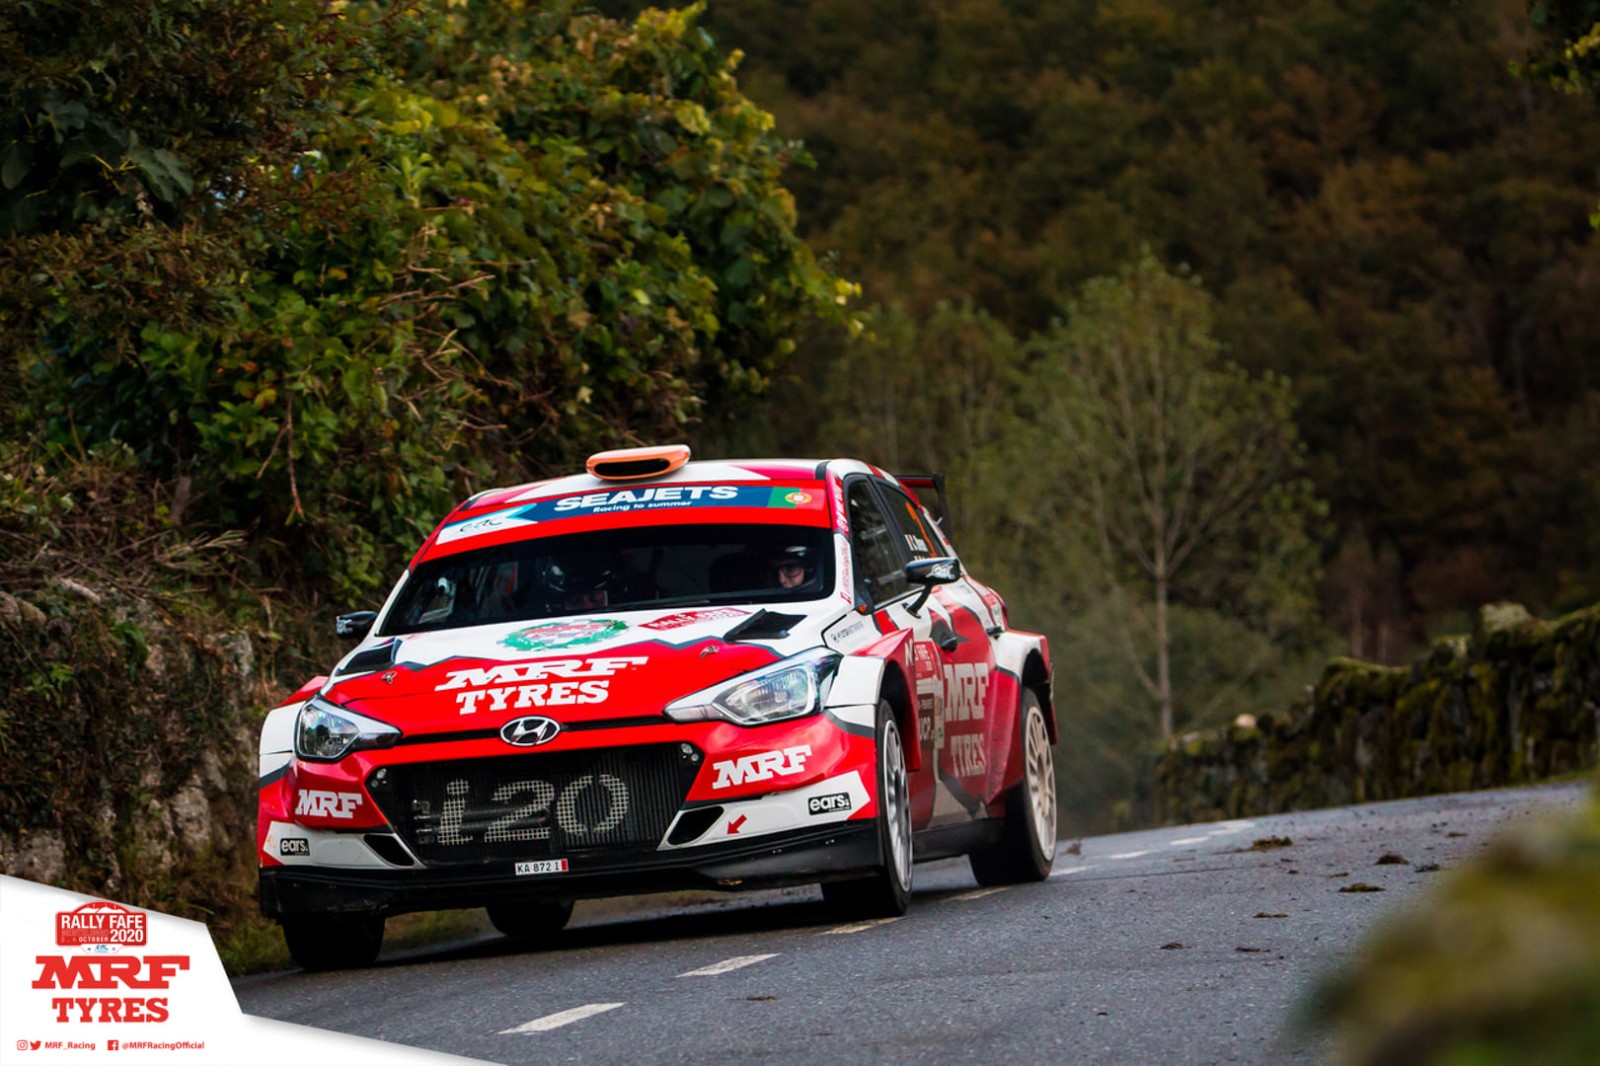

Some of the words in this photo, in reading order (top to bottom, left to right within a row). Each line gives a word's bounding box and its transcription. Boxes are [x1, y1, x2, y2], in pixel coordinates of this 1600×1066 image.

[554, 486, 738, 511] SEAJETS
[593, 503, 630, 513] Racing
[648, 501, 692, 509] summer
[434, 656, 649, 691] MRF
[455, 680, 610, 715] TYRES
[943, 662, 989, 722] MRF
[711, 744, 812, 790] MRF
[951, 733, 986, 777] TYRES
[295, 789, 363, 819] MRF
[437, 774, 629, 845] i20
[517, 863, 530, 874] KA
[533, 861, 551, 873] 872
